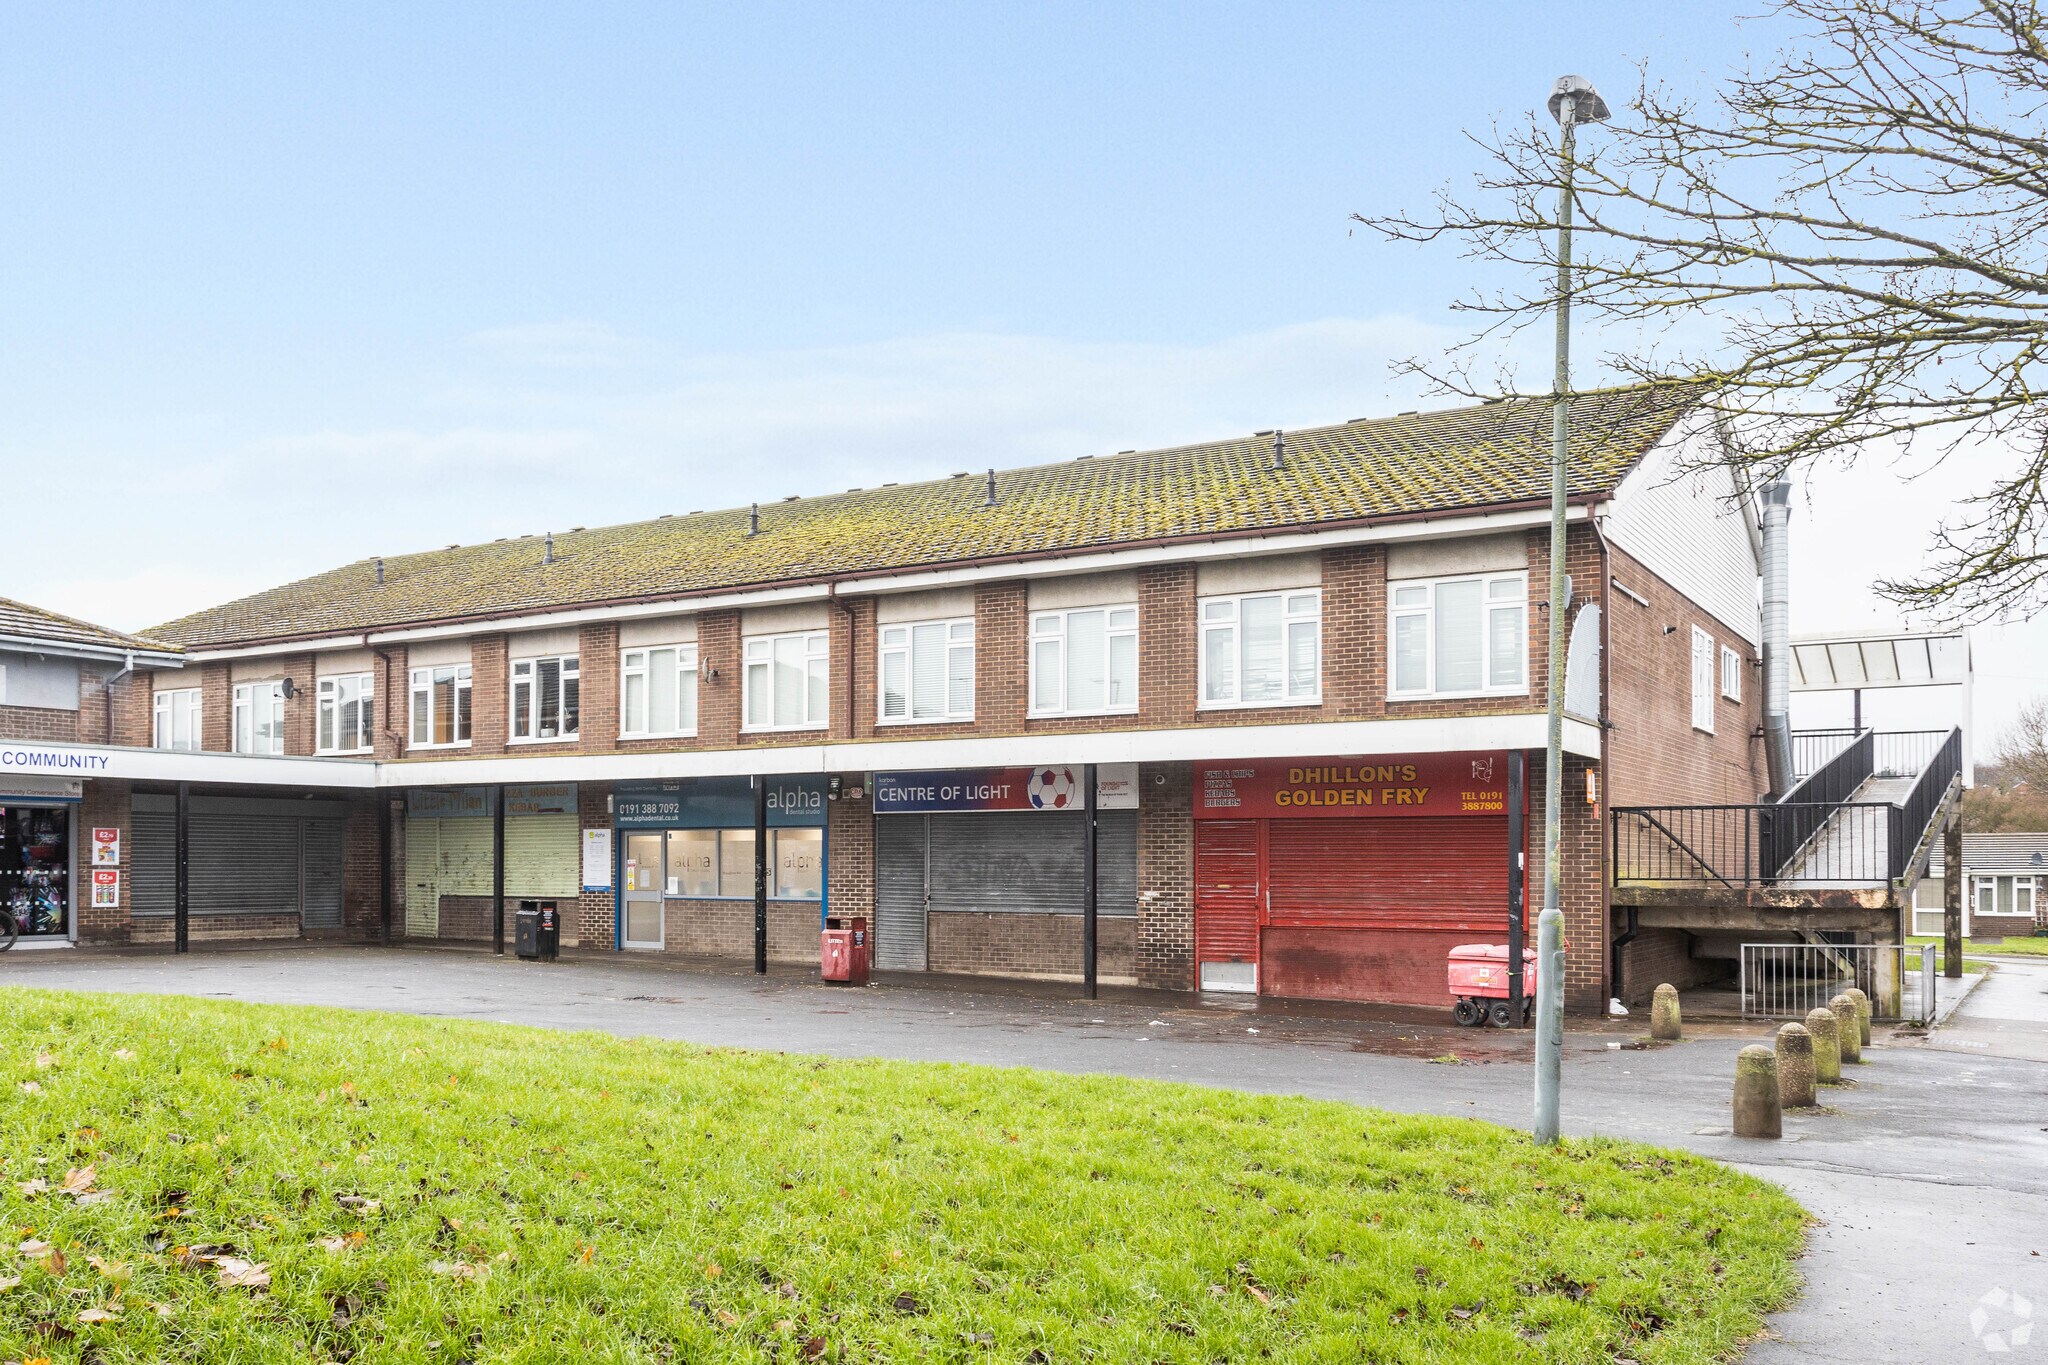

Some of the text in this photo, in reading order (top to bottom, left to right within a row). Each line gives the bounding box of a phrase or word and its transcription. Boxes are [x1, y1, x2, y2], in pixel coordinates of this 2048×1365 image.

[2, 751, 108, 769] COMMUNITY
[1288, 764, 1417, 784] DHILLON'S
[767, 785, 821, 815] alpha
[879, 787, 935, 801] CENTRE
[940, 786, 961, 800] OF
[966, 785, 1011, 799] LIGHT
[1274, 787, 1431, 806] GOLDEN FRY
[1461, 791, 1502, 800] TEL 0191
[620, 803, 679, 814] 0191 388 7092
[1205, 798, 1241, 807] BURGERS
[1462, 801, 1503, 811] 3887800
